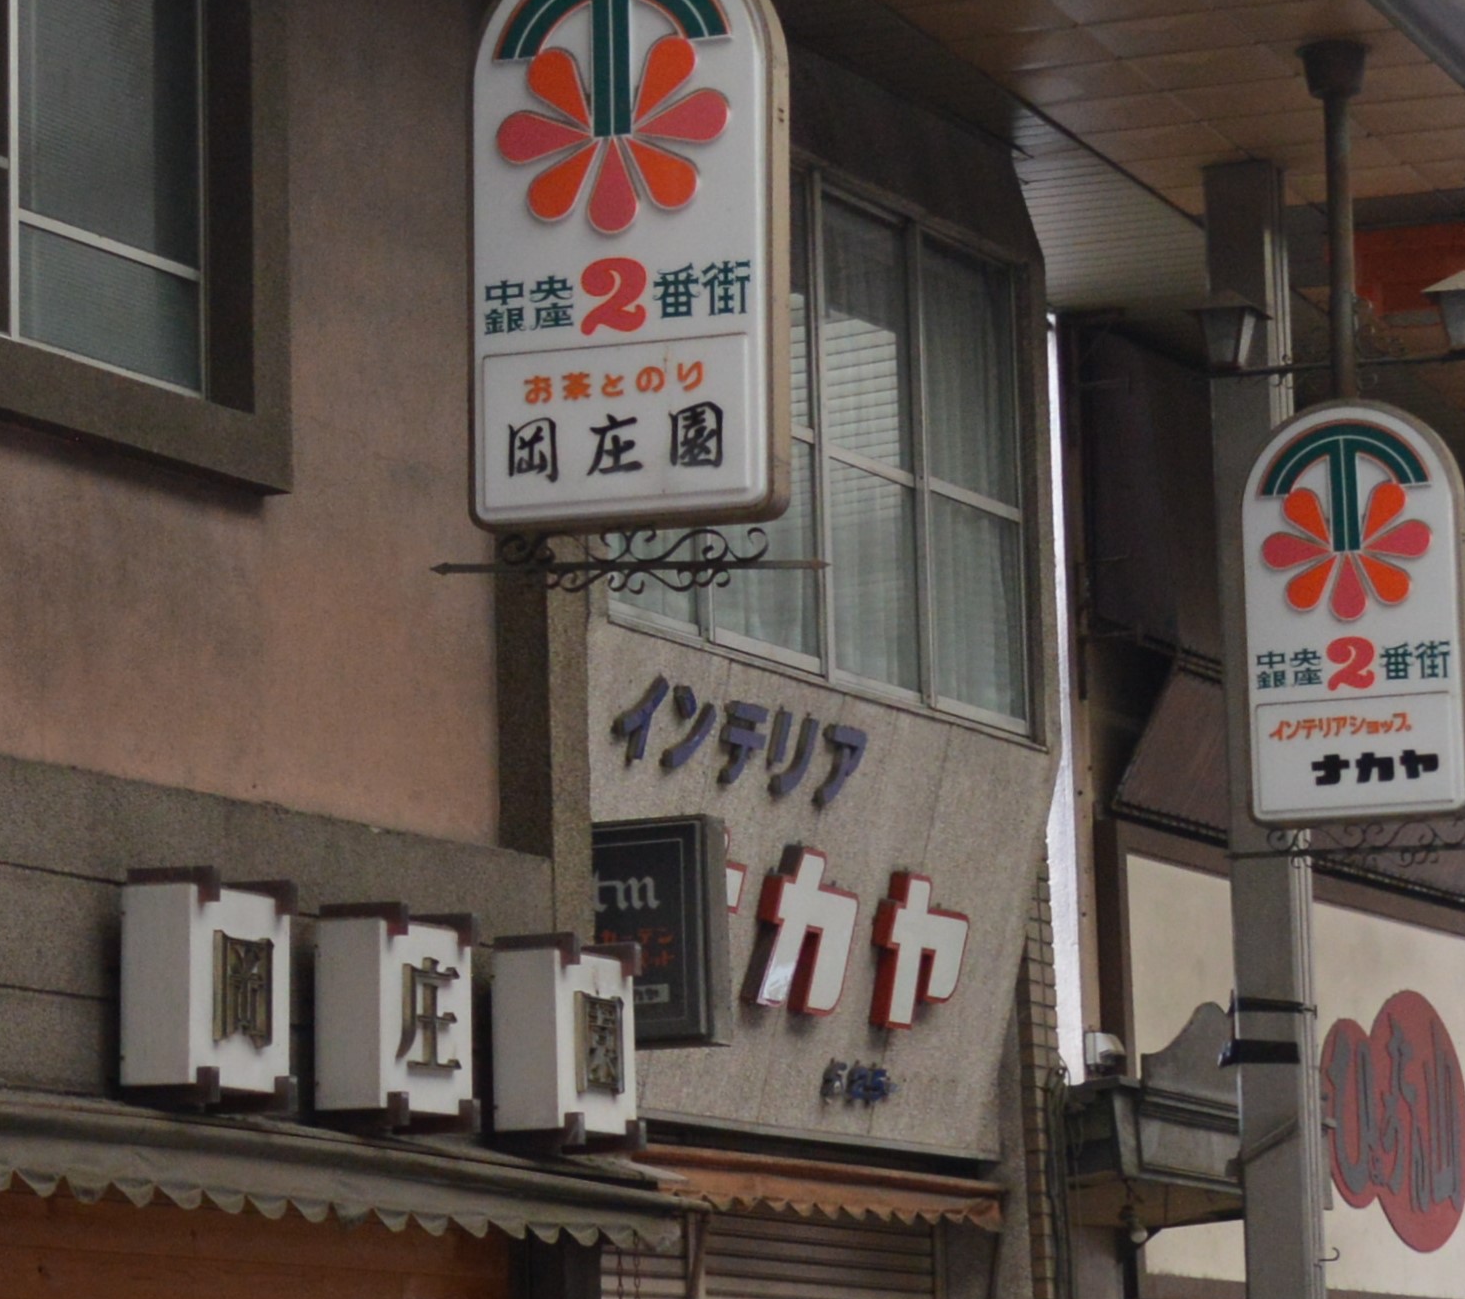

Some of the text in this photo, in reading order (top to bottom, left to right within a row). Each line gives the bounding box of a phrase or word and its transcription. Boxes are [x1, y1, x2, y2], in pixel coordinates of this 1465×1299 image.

[484, 274, 574, 307] 中央
[483, 302, 575, 336] 銀座
[524, 361, 705, 405] お茶とのり
[507, 401, 725, 483] 岡庄園
[611, 674, 868, 806] インテリア
[1311, 749, 1440, 787] ナカヤ
[724, 828, 970, 1031] カヤ
